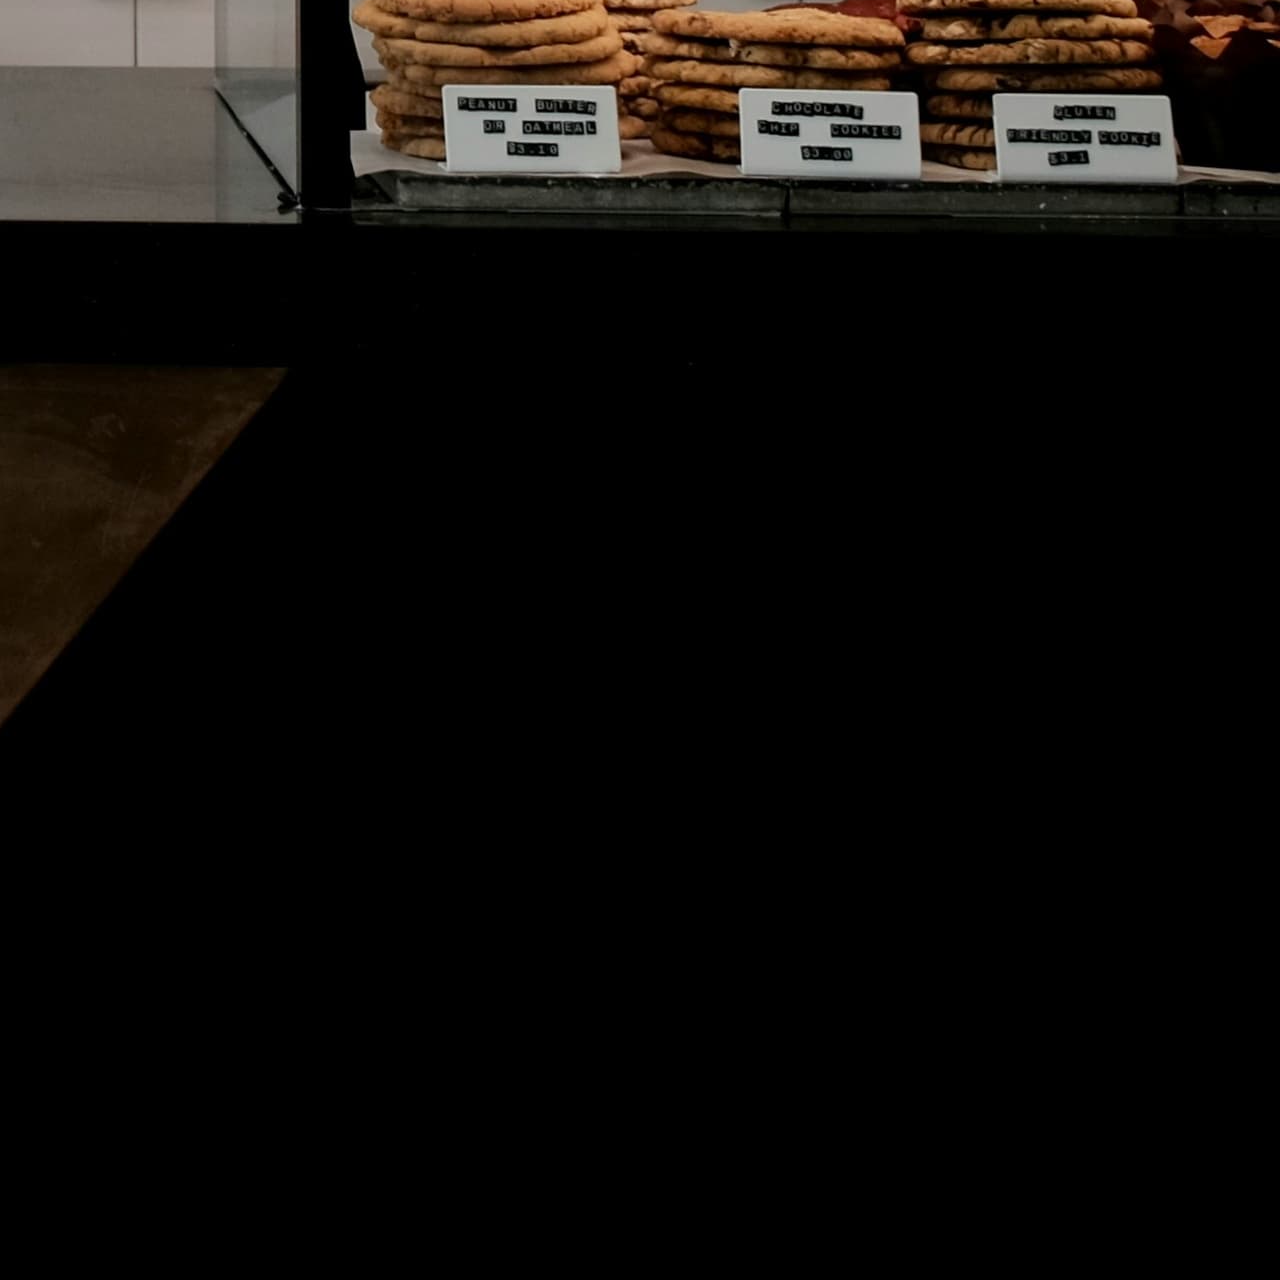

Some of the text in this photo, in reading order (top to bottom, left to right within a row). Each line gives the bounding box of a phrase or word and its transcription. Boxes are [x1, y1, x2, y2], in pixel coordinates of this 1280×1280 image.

[458, 98, 595, 114] PEANUT BUTTER
[772, 102, 863, 119] CHOCOLATE
[1055, 106, 1115, 119] GLUTEN
[484, 120, 596, 134] OR OATMEAL
[759, 121, 901, 138] CHIP COOKIES
[1008, 129, 1160, 145] FRIENDLY COOKIE
[508, 142, 558, 155] $3.10
[802, 147, 852, 160] $3.00
